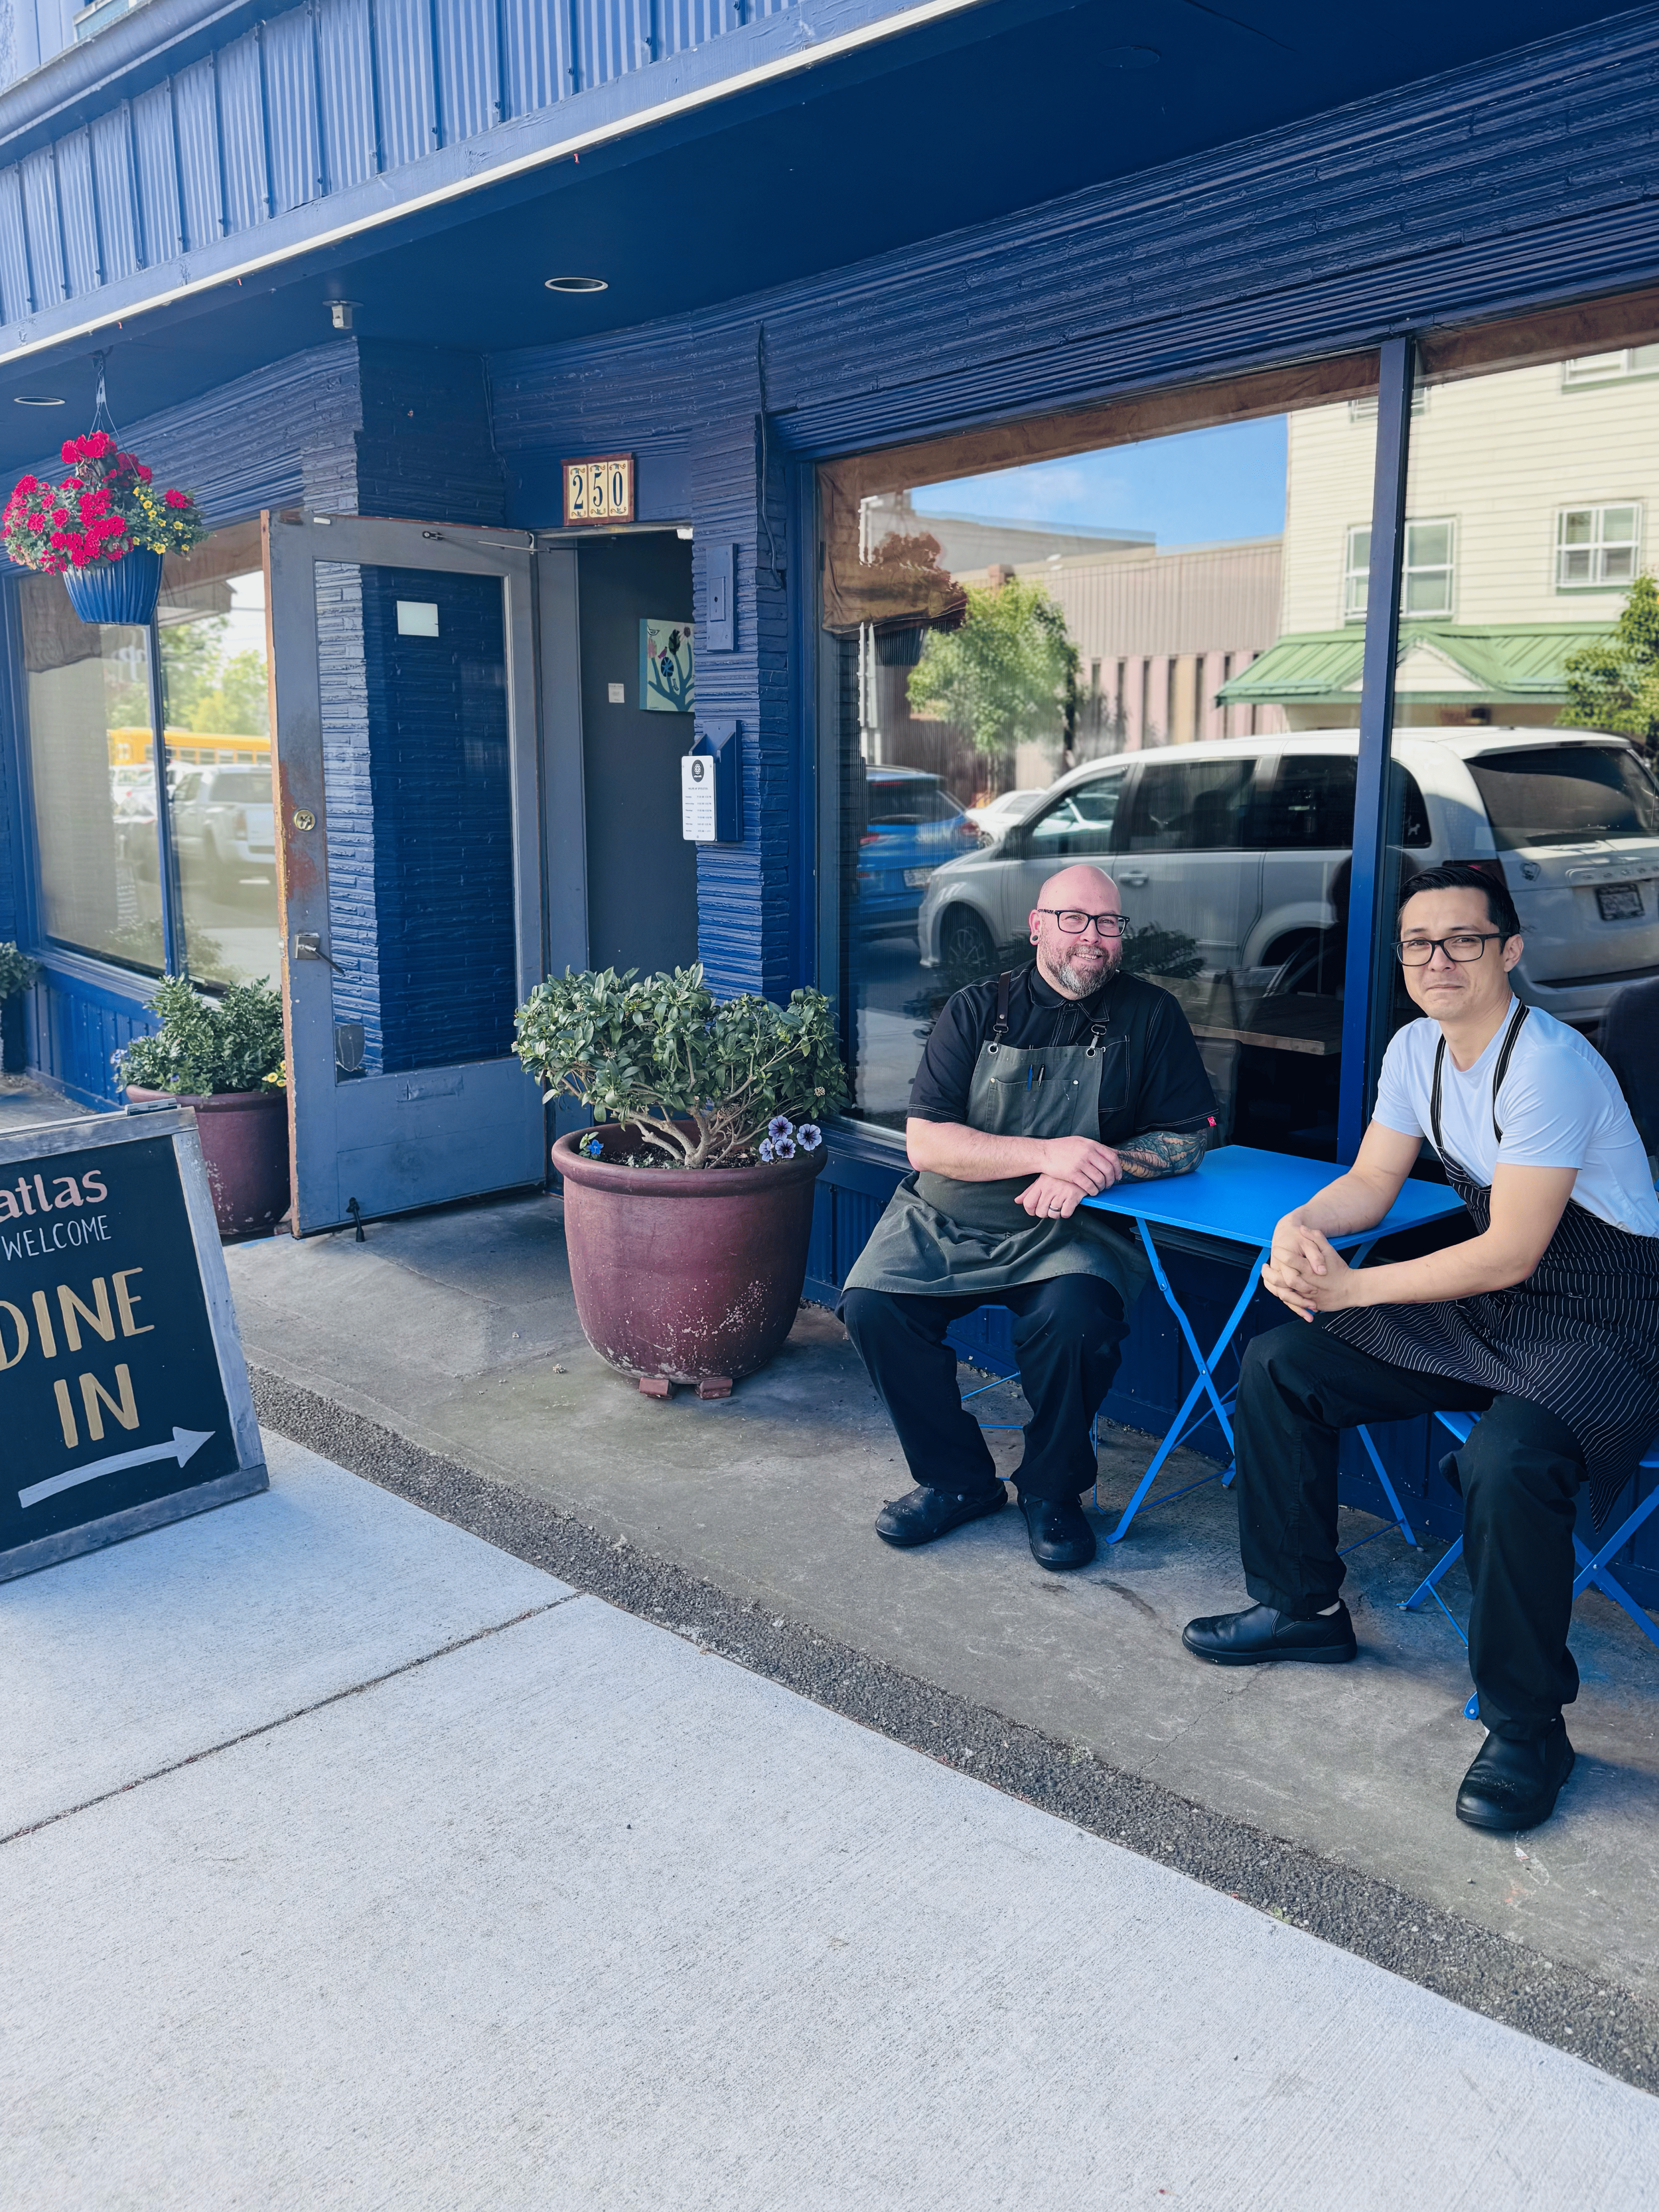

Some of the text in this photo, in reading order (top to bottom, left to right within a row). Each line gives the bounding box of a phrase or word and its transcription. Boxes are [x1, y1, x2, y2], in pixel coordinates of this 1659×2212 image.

[572, 471, 624, 510] 250
[0, 1169, 108, 1224] atlas
[1, 1215, 112, 1262] WELCOME
[0, 1266, 155, 1372] DINE
[53, 1363, 140, 1449] IN
